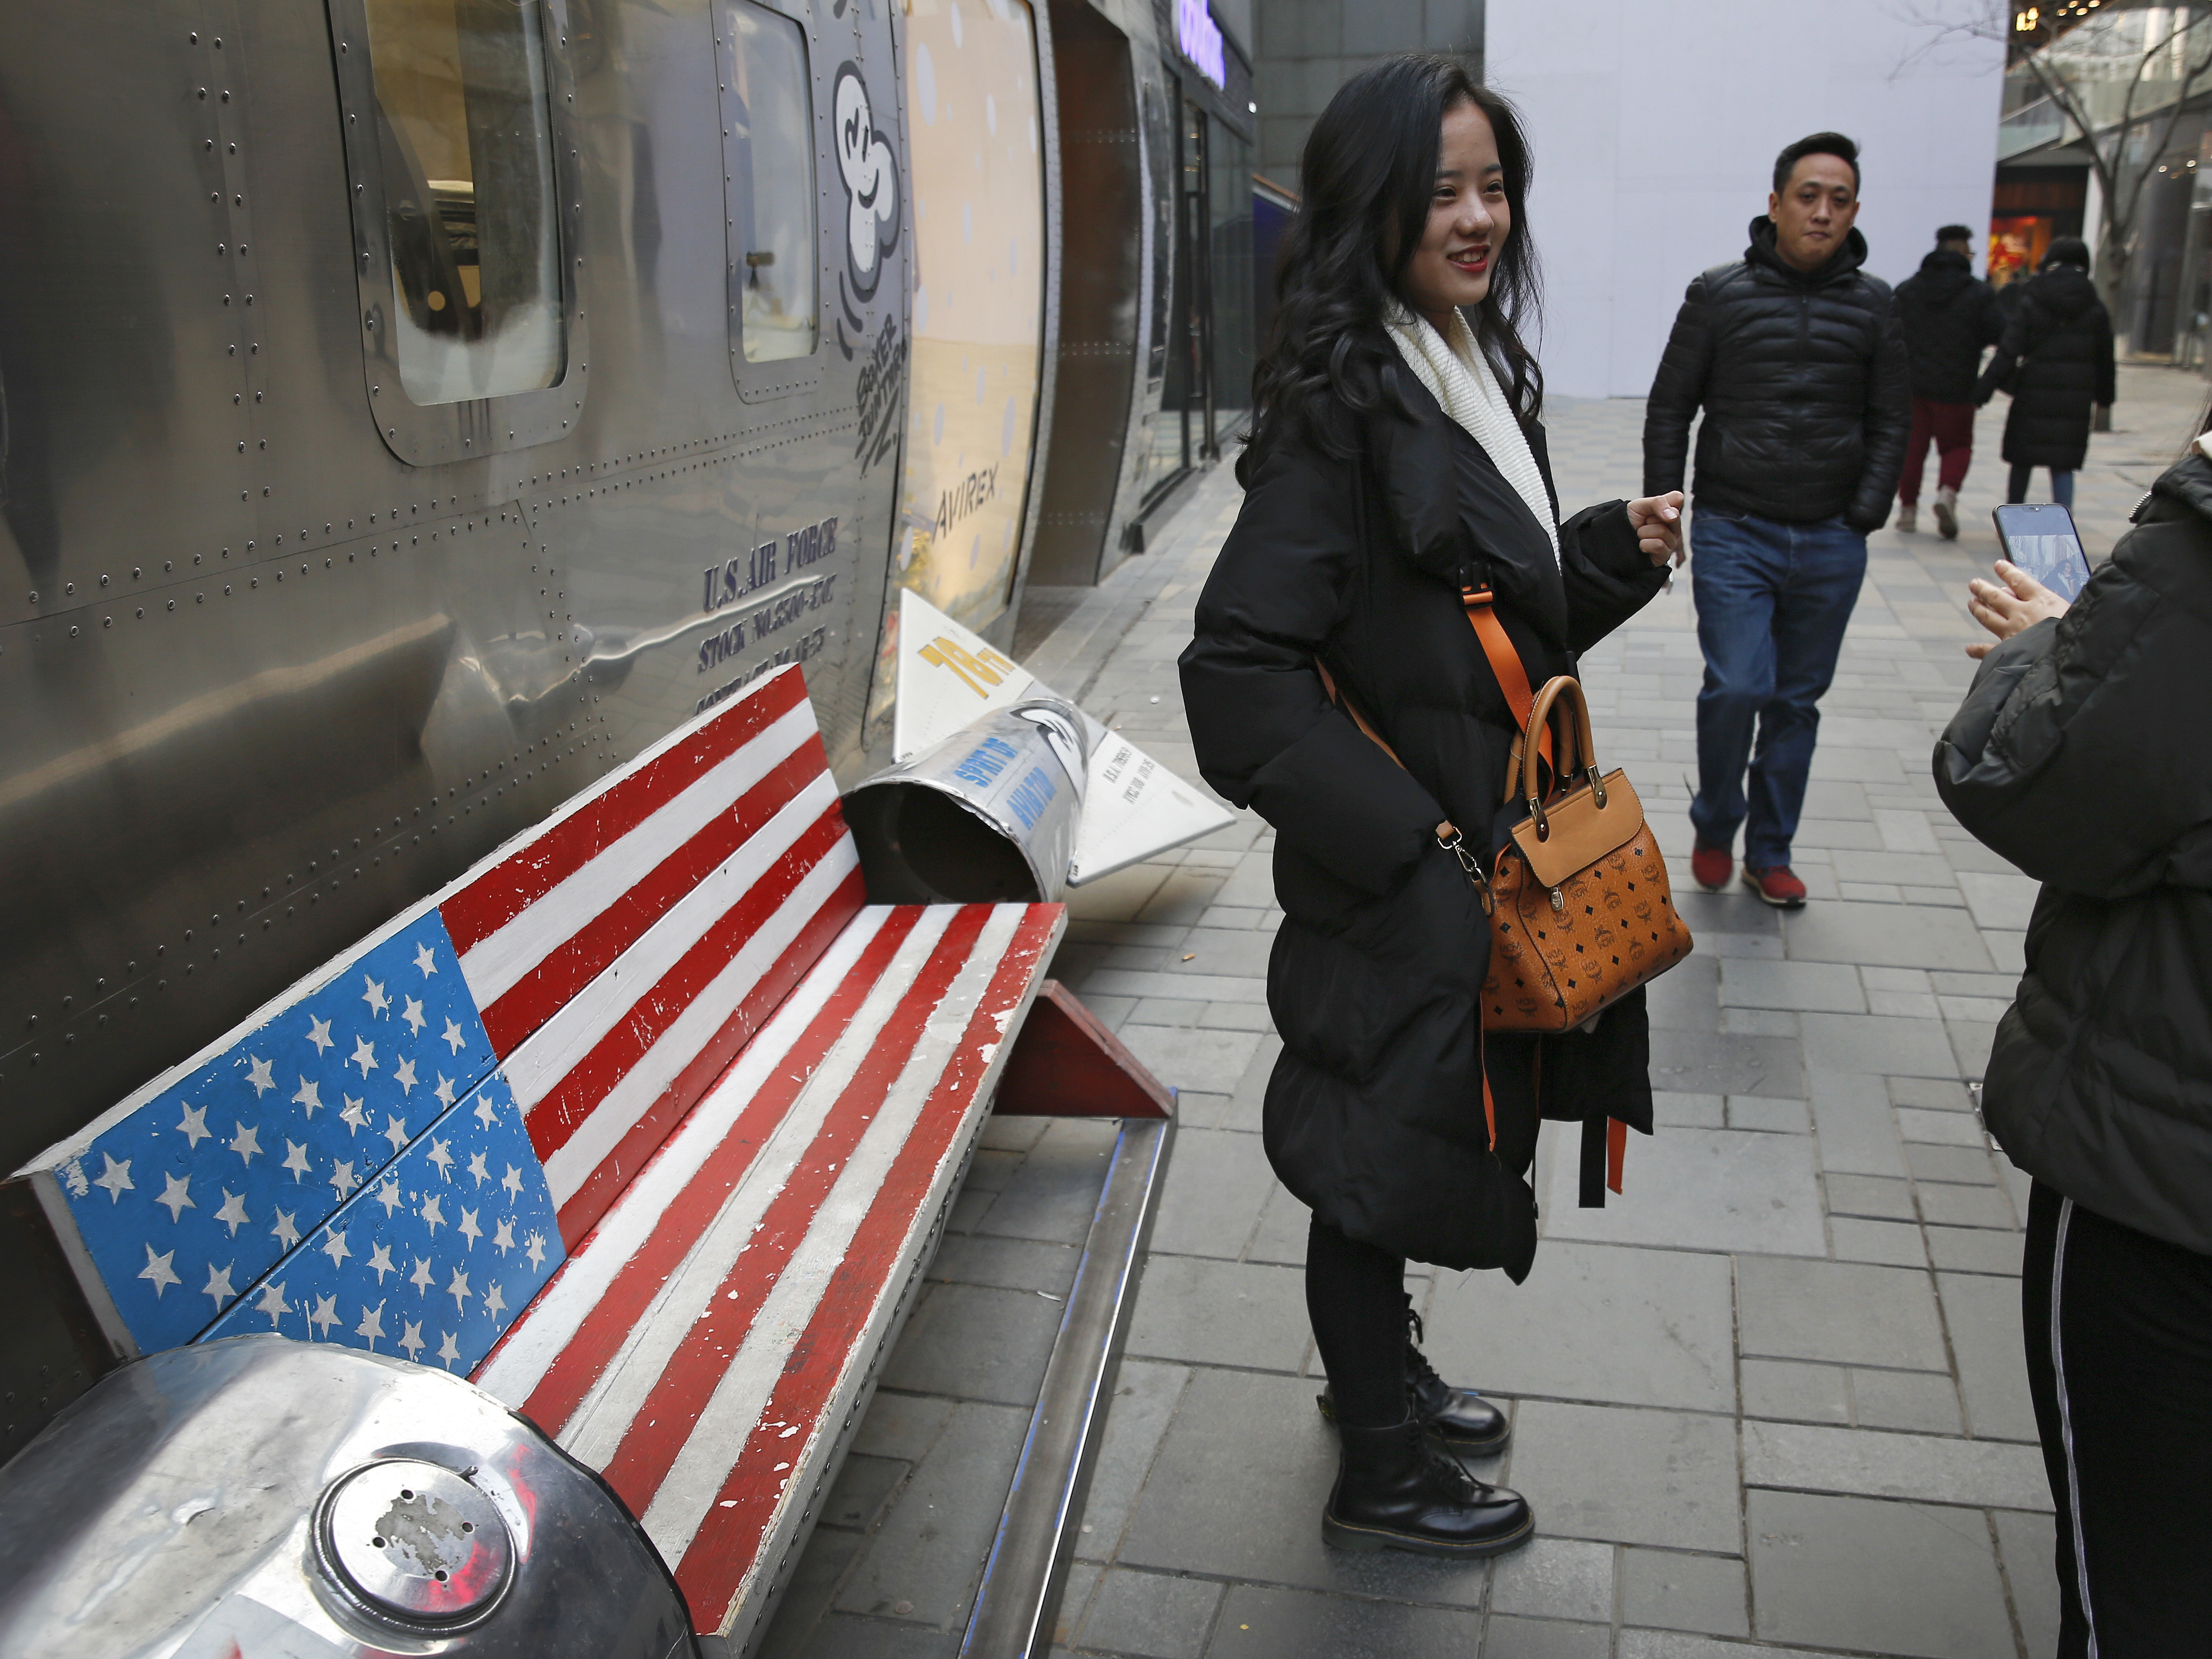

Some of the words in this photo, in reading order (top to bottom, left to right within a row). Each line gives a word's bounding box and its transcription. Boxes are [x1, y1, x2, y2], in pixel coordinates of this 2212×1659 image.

[931, 461, 999, 545] AVIREX
[784, 516, 837, 575] FORCE
[698, 619, 747, 674] STOCK
[982, 737, 1018, 759] OF
[1006, 766, 1057, 831] AVIATOR
[1641, 862, 1657, 876] MCM
[1606, 898, 1622, 911] MCM
[1634, 899, 1649, 914] MCM
[1500, 942, 1522, 953] MCM
[1597, 935, 1615, 950] MCM
[1547, 948, 1563, 962] MCM
[1582, 960, 1599, 973] MCM
[1572, 998, 1588, 1013] MCM
